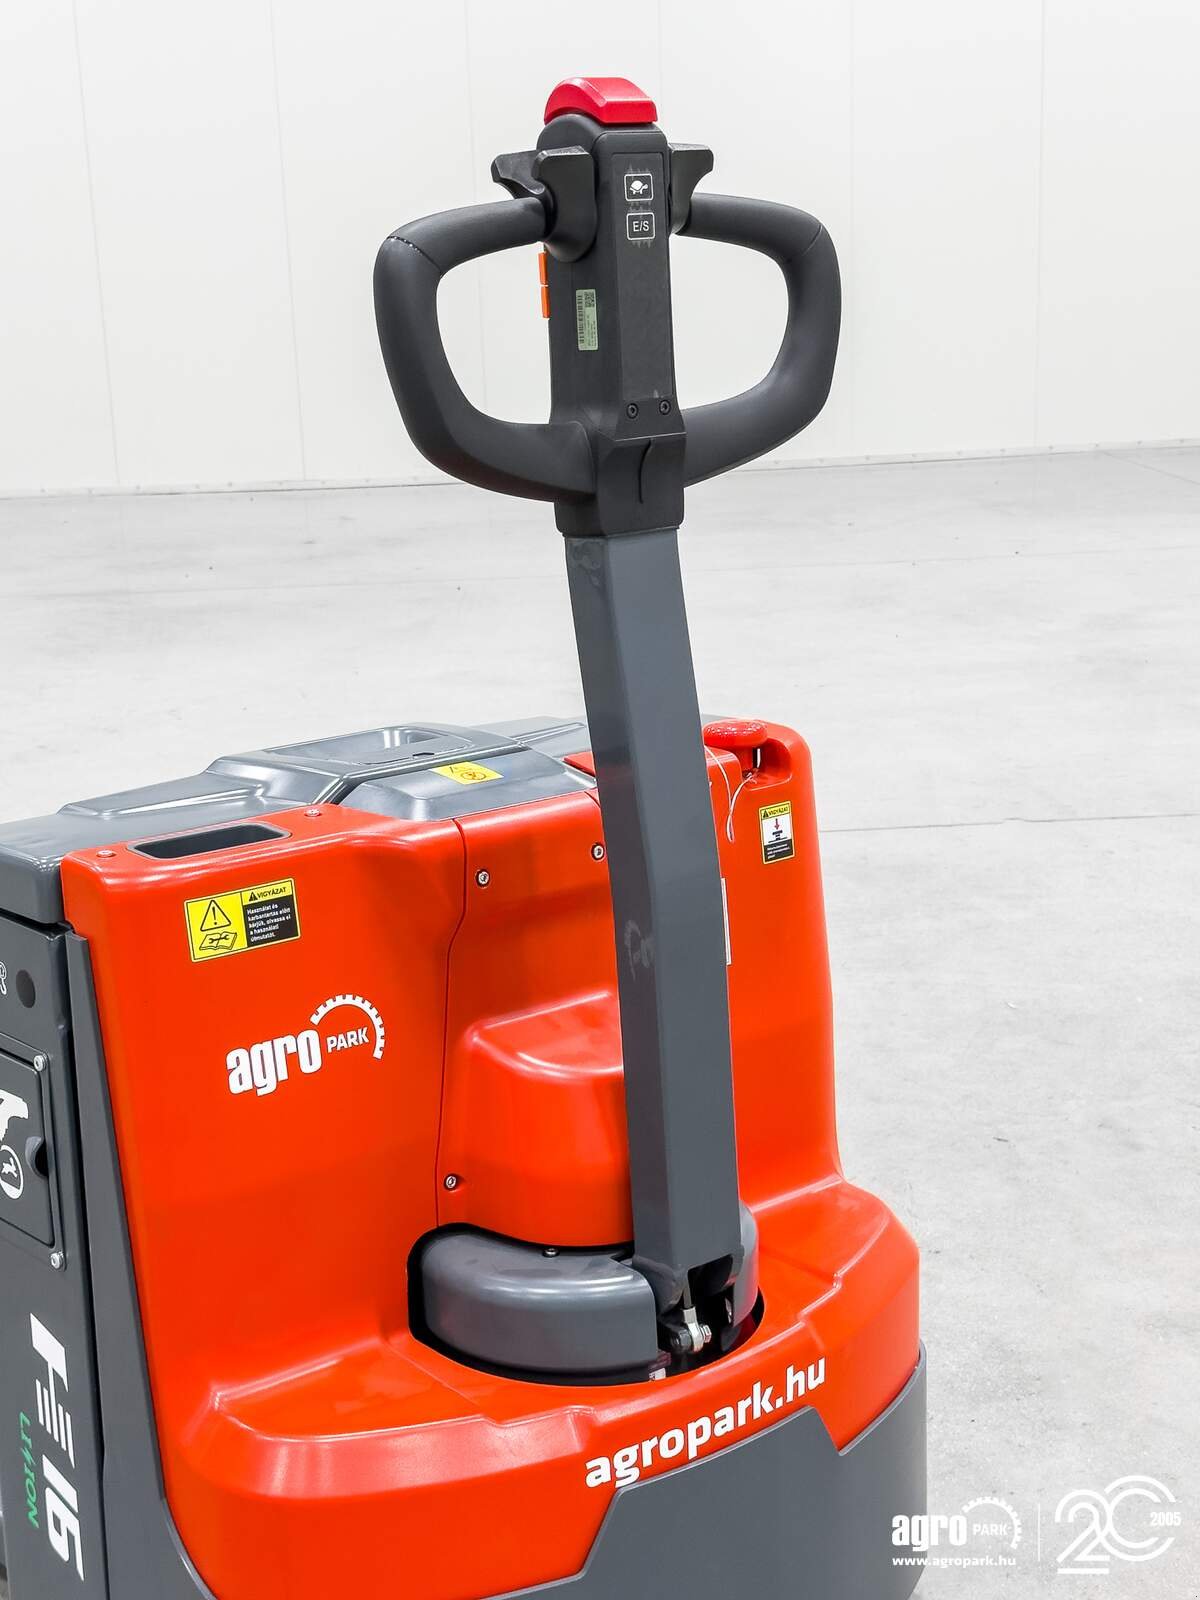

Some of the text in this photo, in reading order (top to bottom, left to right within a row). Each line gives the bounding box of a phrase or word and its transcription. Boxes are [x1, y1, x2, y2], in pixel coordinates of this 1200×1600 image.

[632, 220, 650, 232] E/S
[257, 887, 287, 898] VIGYÁZAT
[226, 1027, 369, 1097] agro PARK
[585, 1357, 826, 1489] agropark.hu
